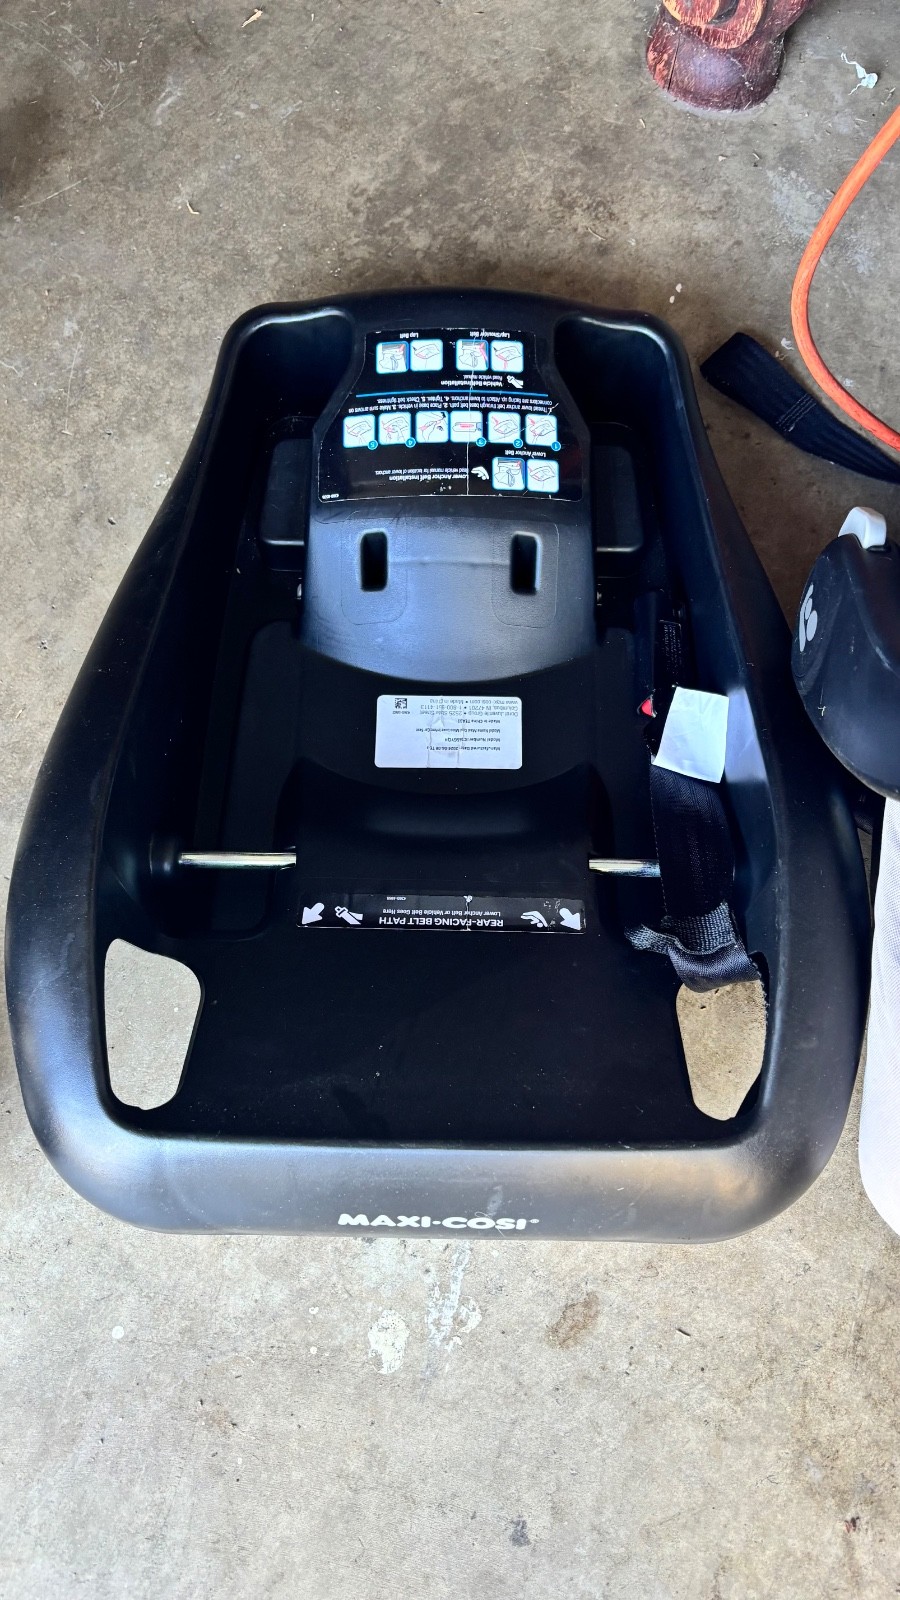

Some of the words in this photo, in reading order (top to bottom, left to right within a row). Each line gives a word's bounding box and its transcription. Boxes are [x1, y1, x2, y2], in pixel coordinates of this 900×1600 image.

[379, 916, 406, 924] PATH
[434, 918, 504, 927] REAR-FACING
[337, 1213, 527, 1230] MAXI-COSI
